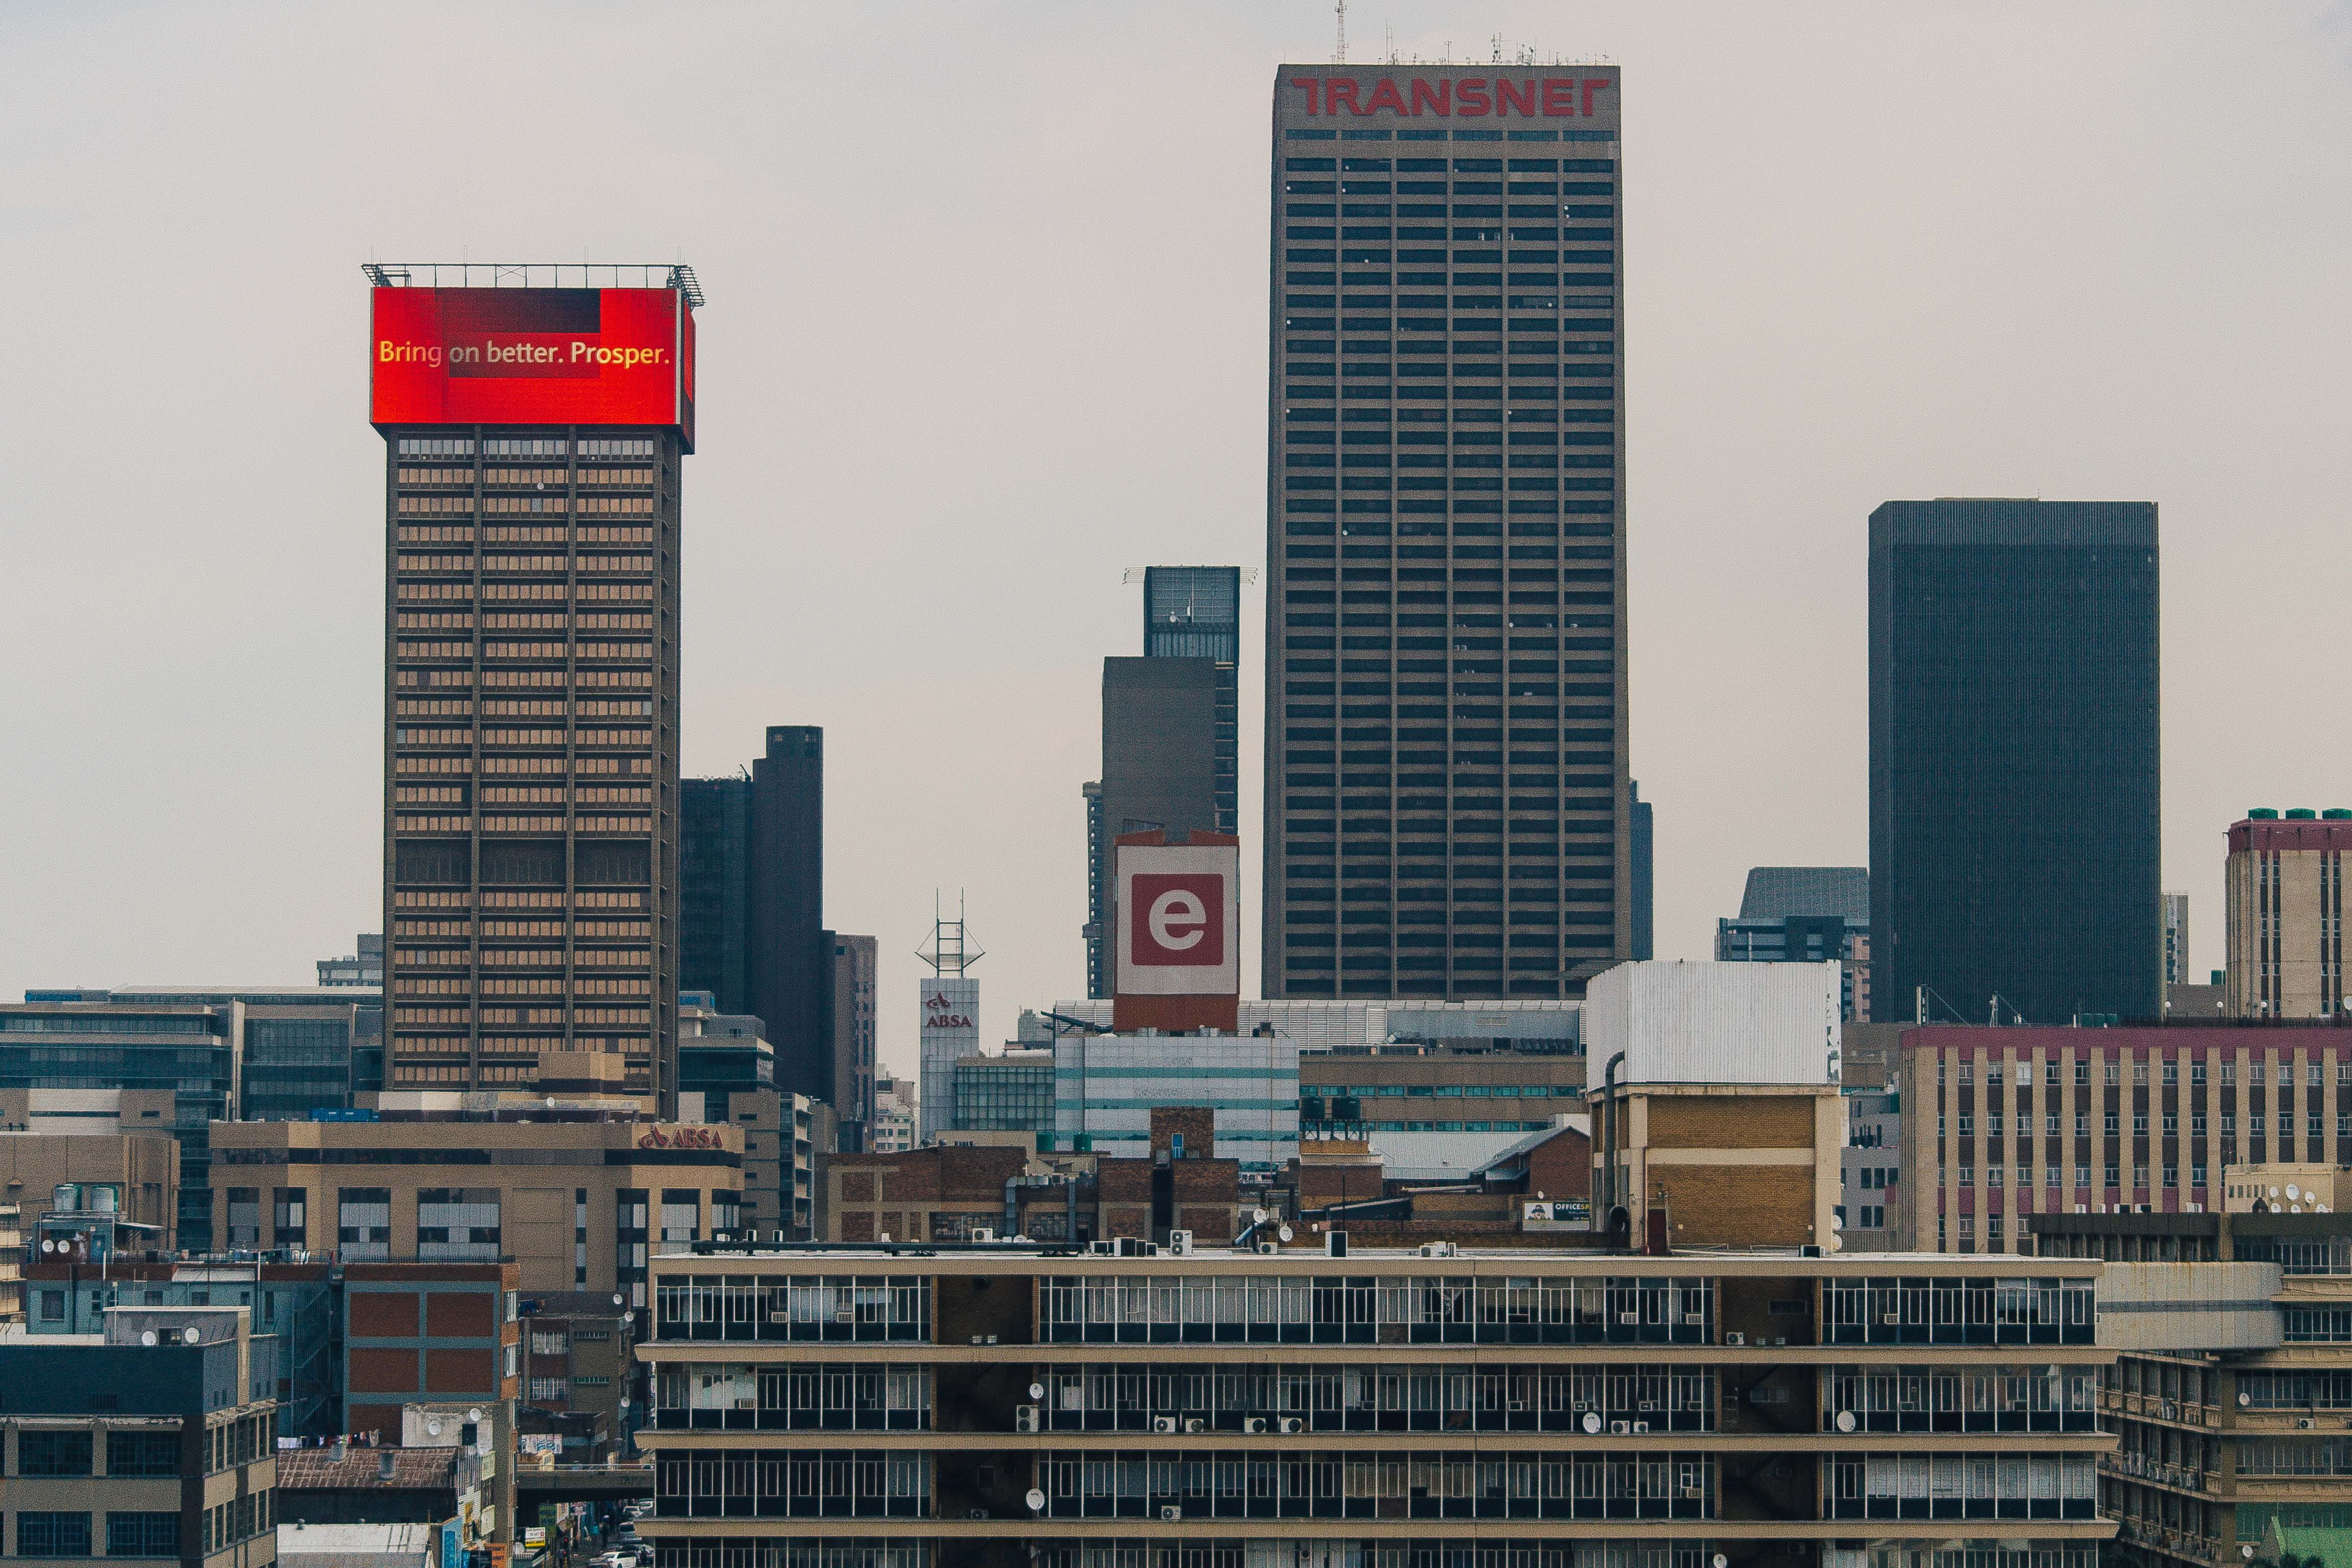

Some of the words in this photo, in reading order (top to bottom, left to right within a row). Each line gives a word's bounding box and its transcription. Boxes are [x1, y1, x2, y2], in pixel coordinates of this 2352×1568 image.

[1291, 78, 1610, 116] TRANSNET
[380, 340, 442, 368] Bring
[449, 346, 479, 362] on
[487, 340, 564, 363] better.
[571, 341, 670, 369] Prosper.
[1149, 889, 1206, 950] e
[926, 1015, 972, 1027] ABSA
[671, 1127, 723, 1147] ABSA
